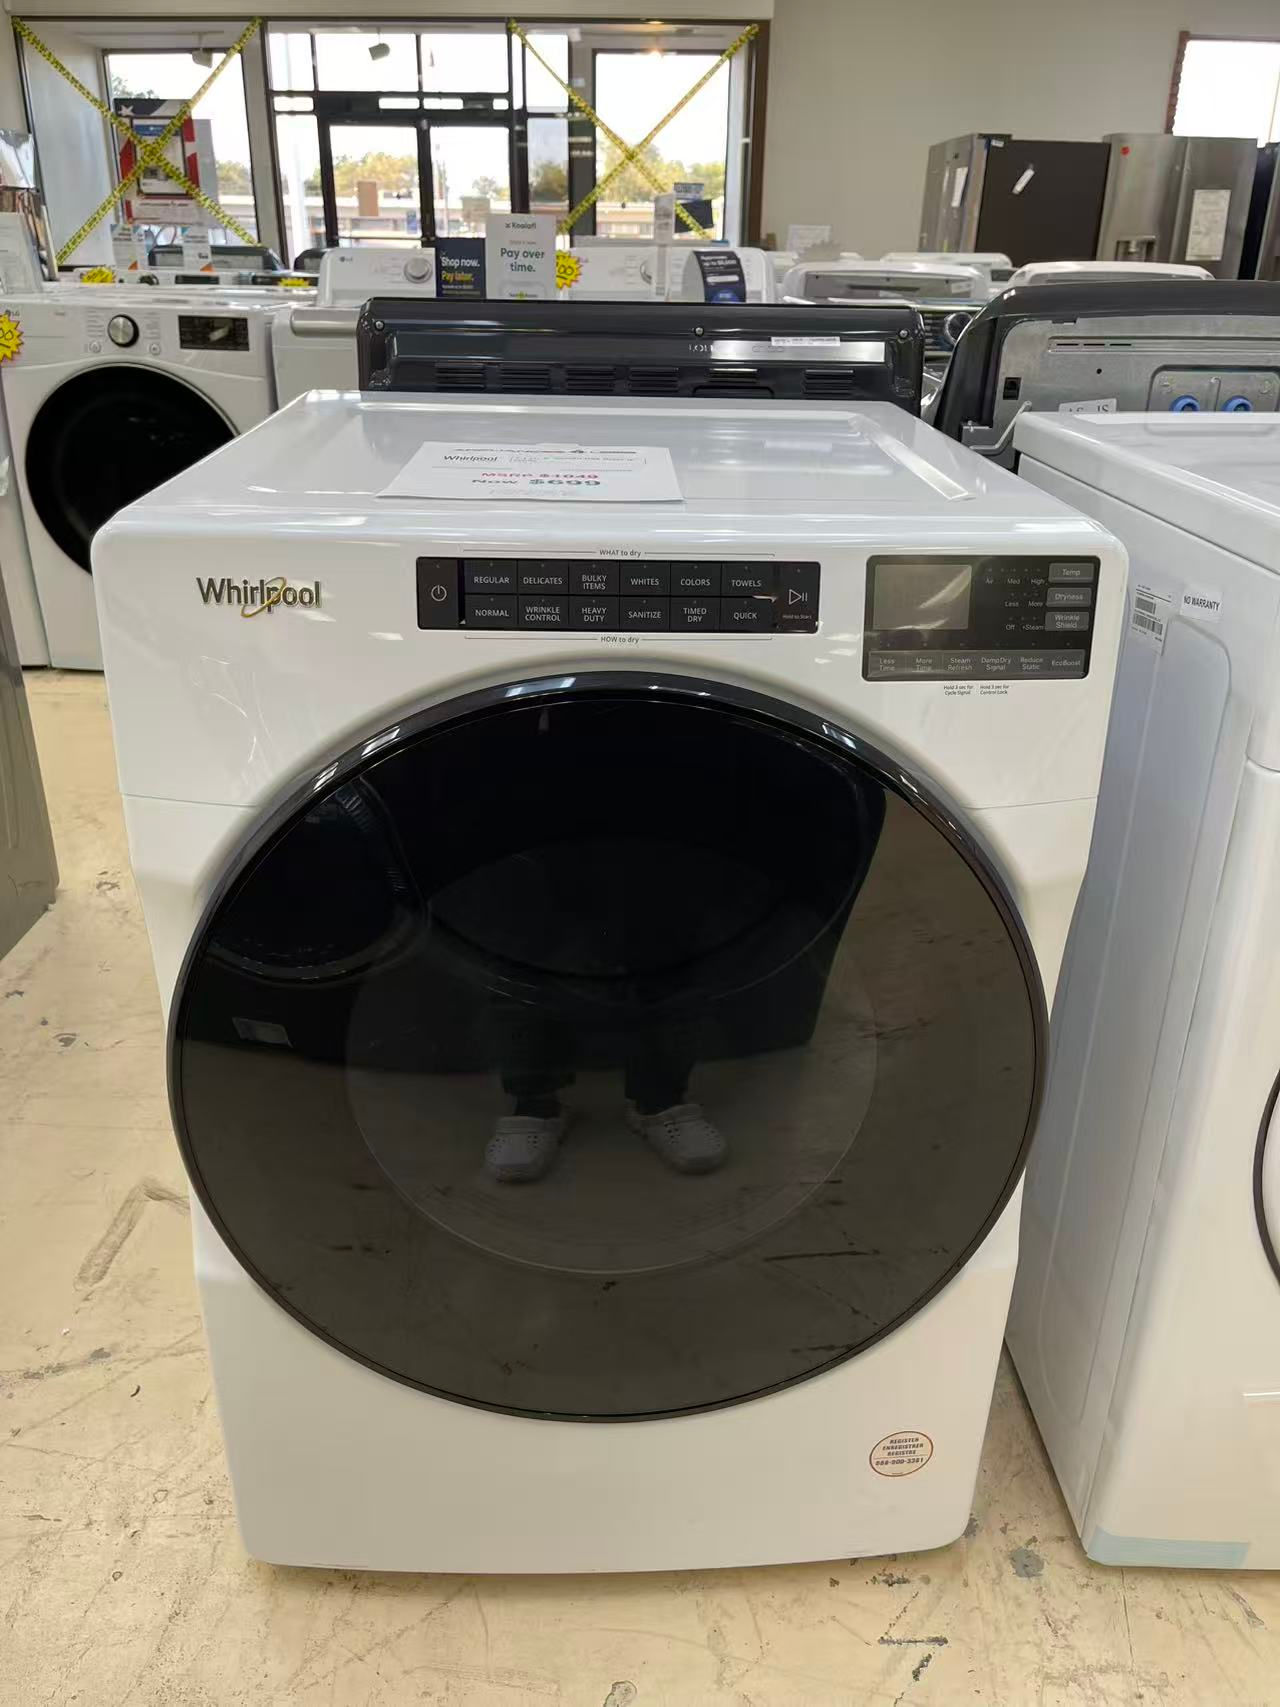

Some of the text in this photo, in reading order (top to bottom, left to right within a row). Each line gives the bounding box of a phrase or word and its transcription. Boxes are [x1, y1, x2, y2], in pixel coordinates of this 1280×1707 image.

[500, 248, 544, 260] Pay over
[441, 257, 481, 268] Shop now.
[510, 262, 536, 273] time.
[443, 455, 498, 463] Whirlpool
[629, 549, 641, 559] dry
[1062, 568, 1081, 577] Temp
[473, 576, 510, 584] REGULAR
[522, 577, 563, 585] DELICATES
[582, 575, 607, 583] BULKY
[630, 578, 660, 586] WHITES
[680, 578, 711, 586] COLORS
[731, 579, 762, 587] TOWELS
[1031, 578, 1045, 586] High
[583, 583, 606, 591] ITEMS
[195, 577, 322, 614] Whirlpool
[1055, 593, 1084, 602] Dryness
[1183, 595, 1221, 611] NO WARRANTY
[475, 609, 509, 617] NORMAL
[525, 606, 560, 614] WRINKLE
[683, 607, 707, 615] TIMED
[524, 614, 561, 622] CONTROL
[583, 615, 605, 623] DUTY
[628, 611, 662, 619] SANITIZE
[687, 615, 703, 623] DRY
[733, 611, 758, 620] QUICK
[1055, 621, 1078, 629] Shield
[627, 637, 640, 645] dry
[986, 664, 1006, 672] Signal
